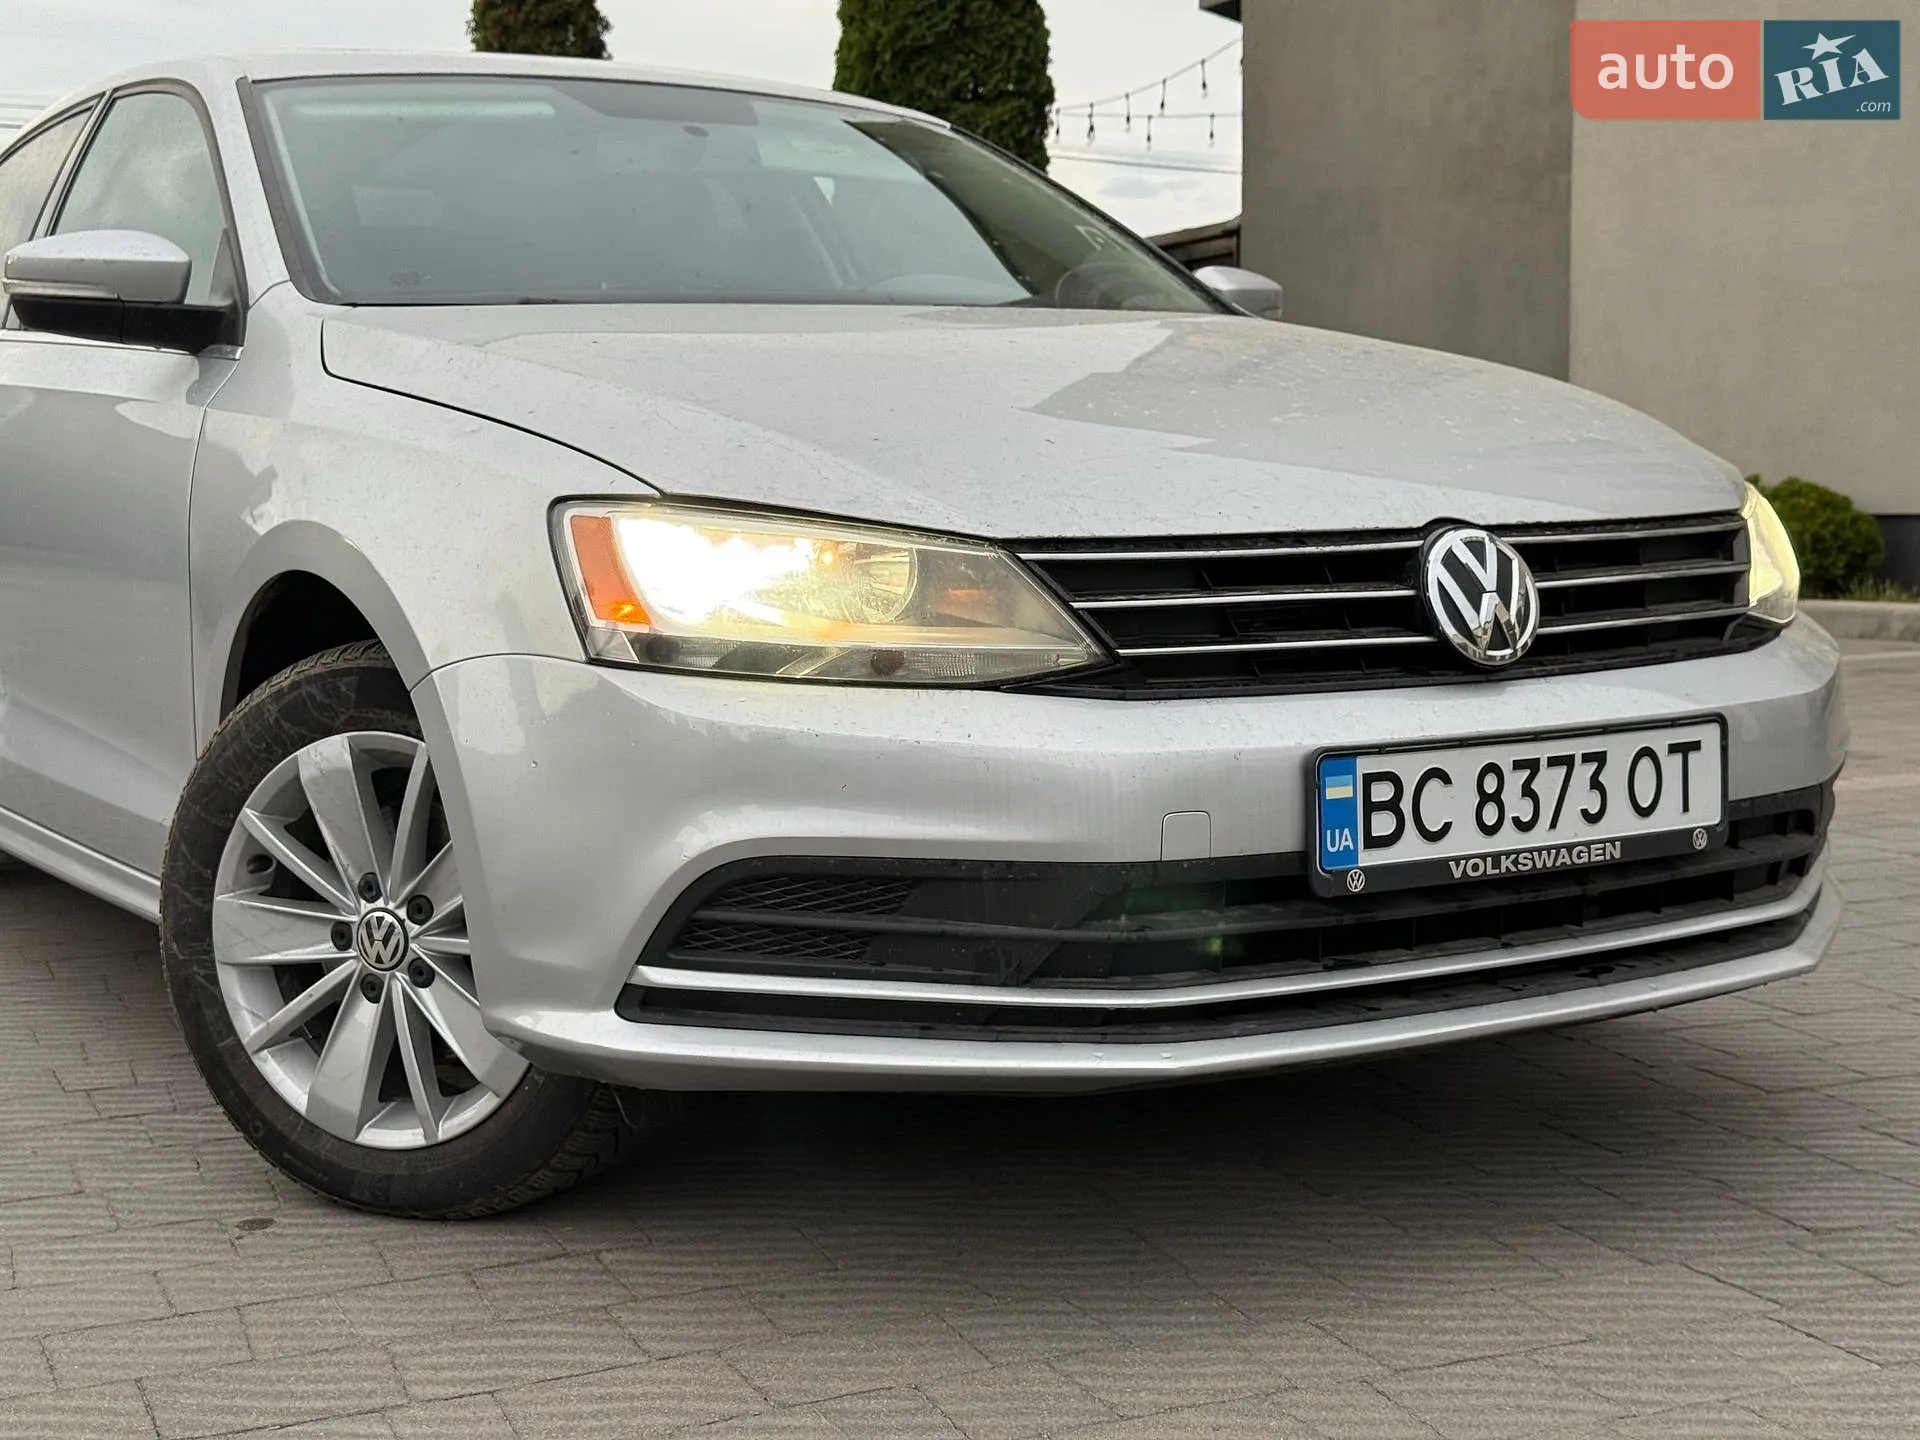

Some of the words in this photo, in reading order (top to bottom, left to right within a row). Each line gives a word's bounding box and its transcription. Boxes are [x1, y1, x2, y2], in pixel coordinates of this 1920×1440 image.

[1362, 767, 1454, 850] BC
[1475, 750, 1608, 837] 8373
[1628, 741, 1702, 818] OT
[1327, 828, 1354, 853] UA
[1449, 841, 1621, 879] VOLKSWAGEN
